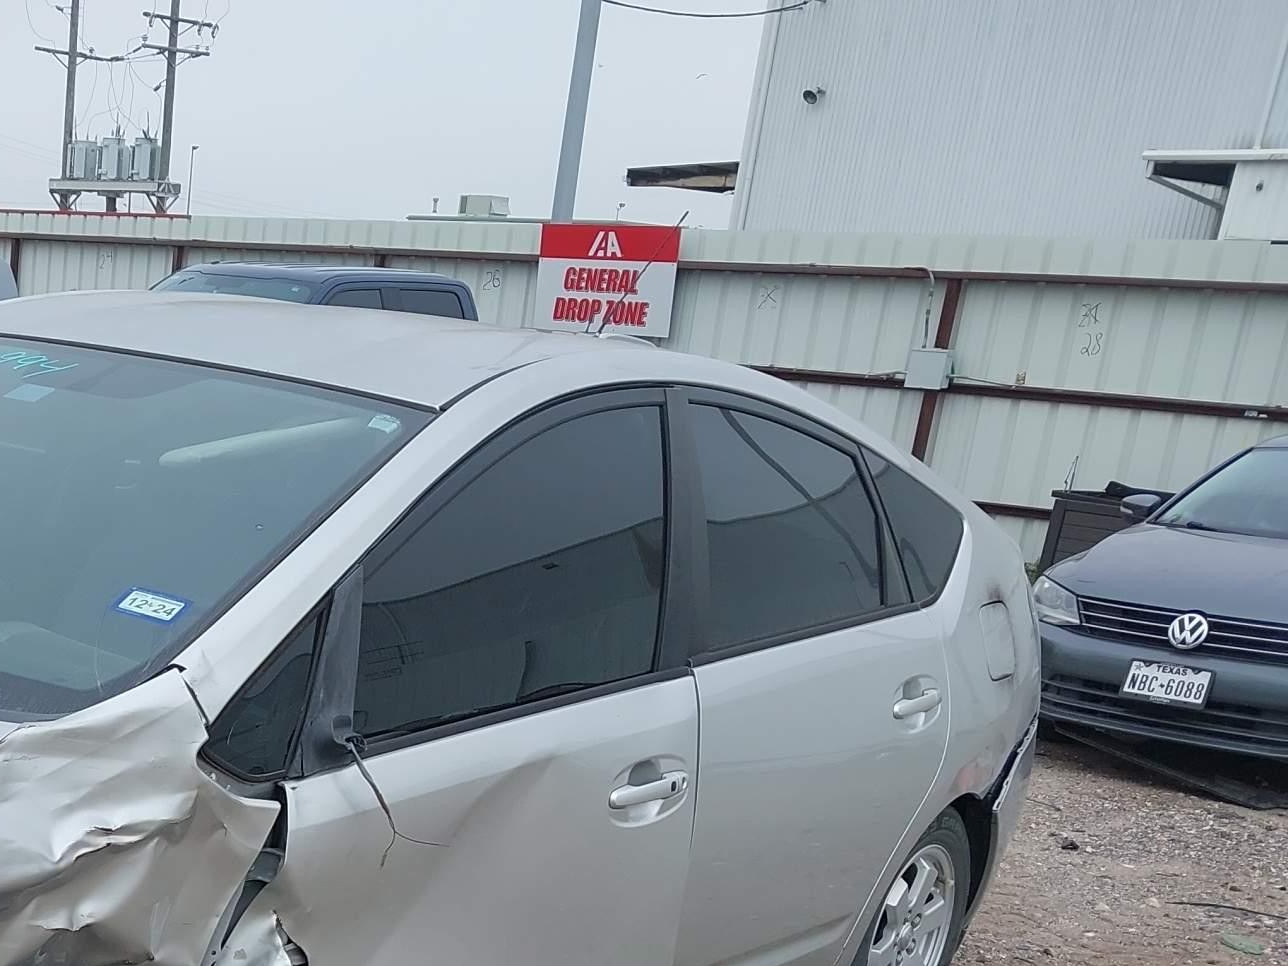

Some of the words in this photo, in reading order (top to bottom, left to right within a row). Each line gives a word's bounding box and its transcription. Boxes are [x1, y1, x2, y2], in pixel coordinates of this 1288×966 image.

[482, 269, 501, 291] 26
[563, 266, 639, 296] GENERAL
[553, 297, 604, 324] DROP
[602, 299, 650, 327] ZONE
[1080, 331, 1104, 357] 28
[128, 597, 149, 609] 12
[152, 603, 177, 617] 24
[1156, 664, 1189, 677] TEXAS
